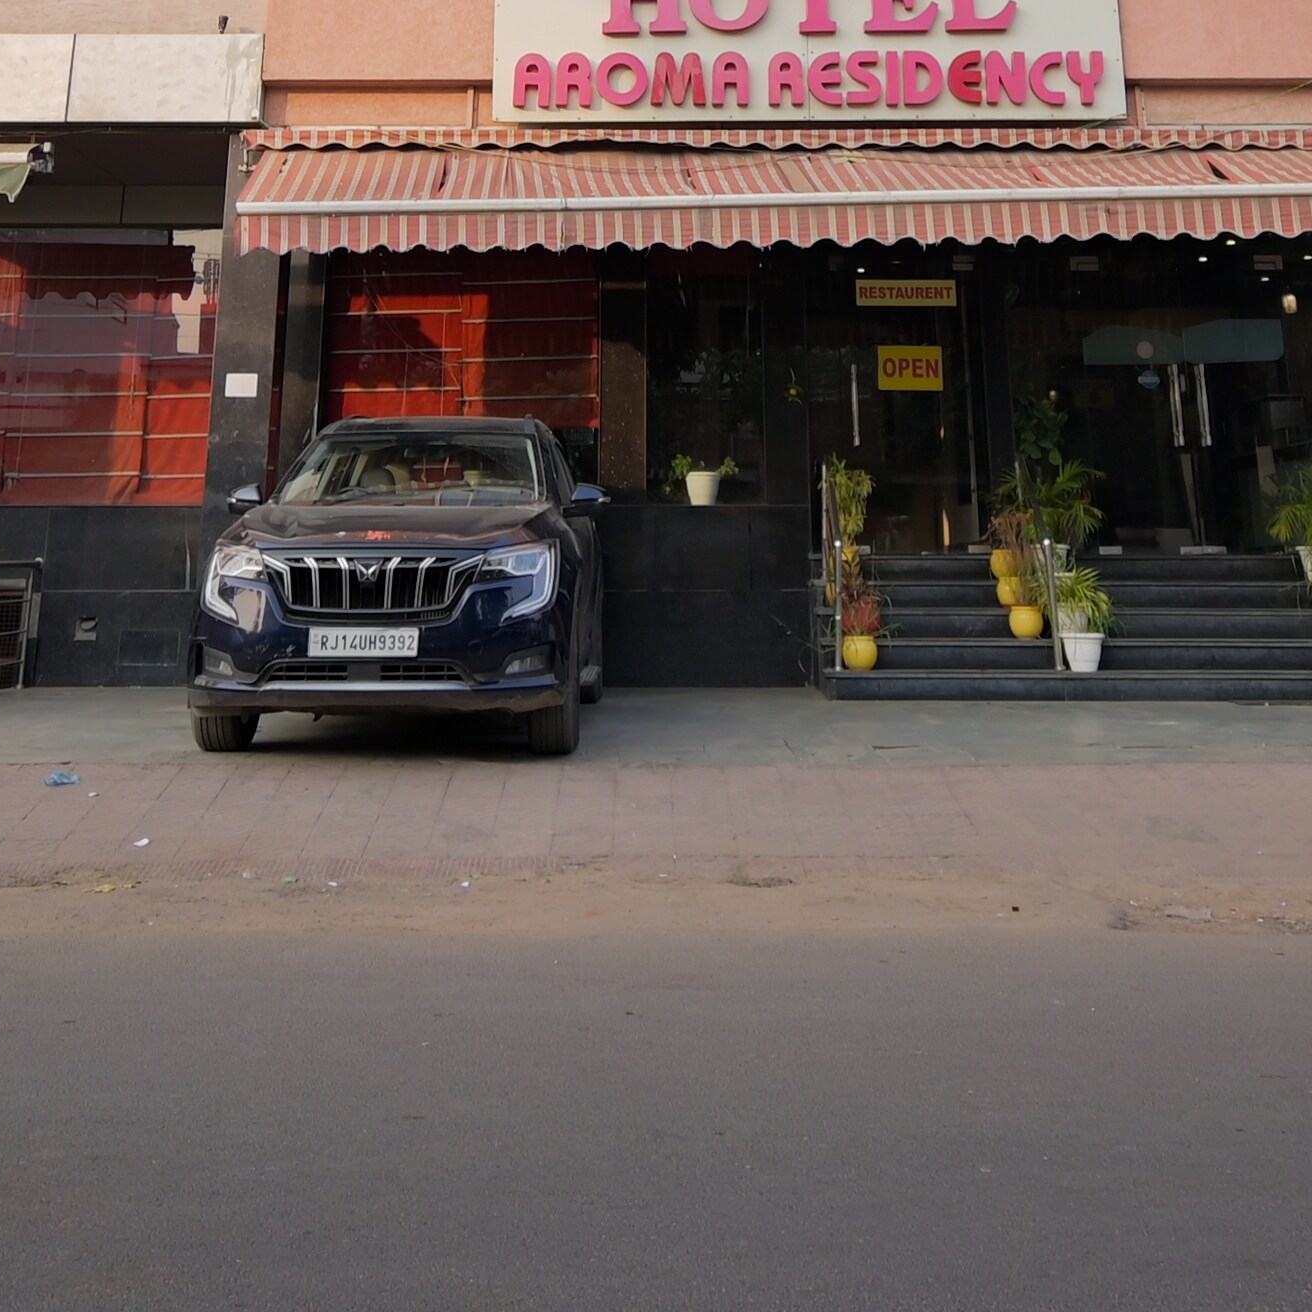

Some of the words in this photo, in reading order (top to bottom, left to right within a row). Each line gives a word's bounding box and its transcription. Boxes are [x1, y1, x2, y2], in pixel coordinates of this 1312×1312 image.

[513, 51, 749, 108] AROMA
[768, 49, 1104, 108] RESIDENCY
[859, 286, 953, 300] RESTAURENT
[882, 357, 940, 378] OPEN
[319, 634, 416, 652] RJ14UH9392
